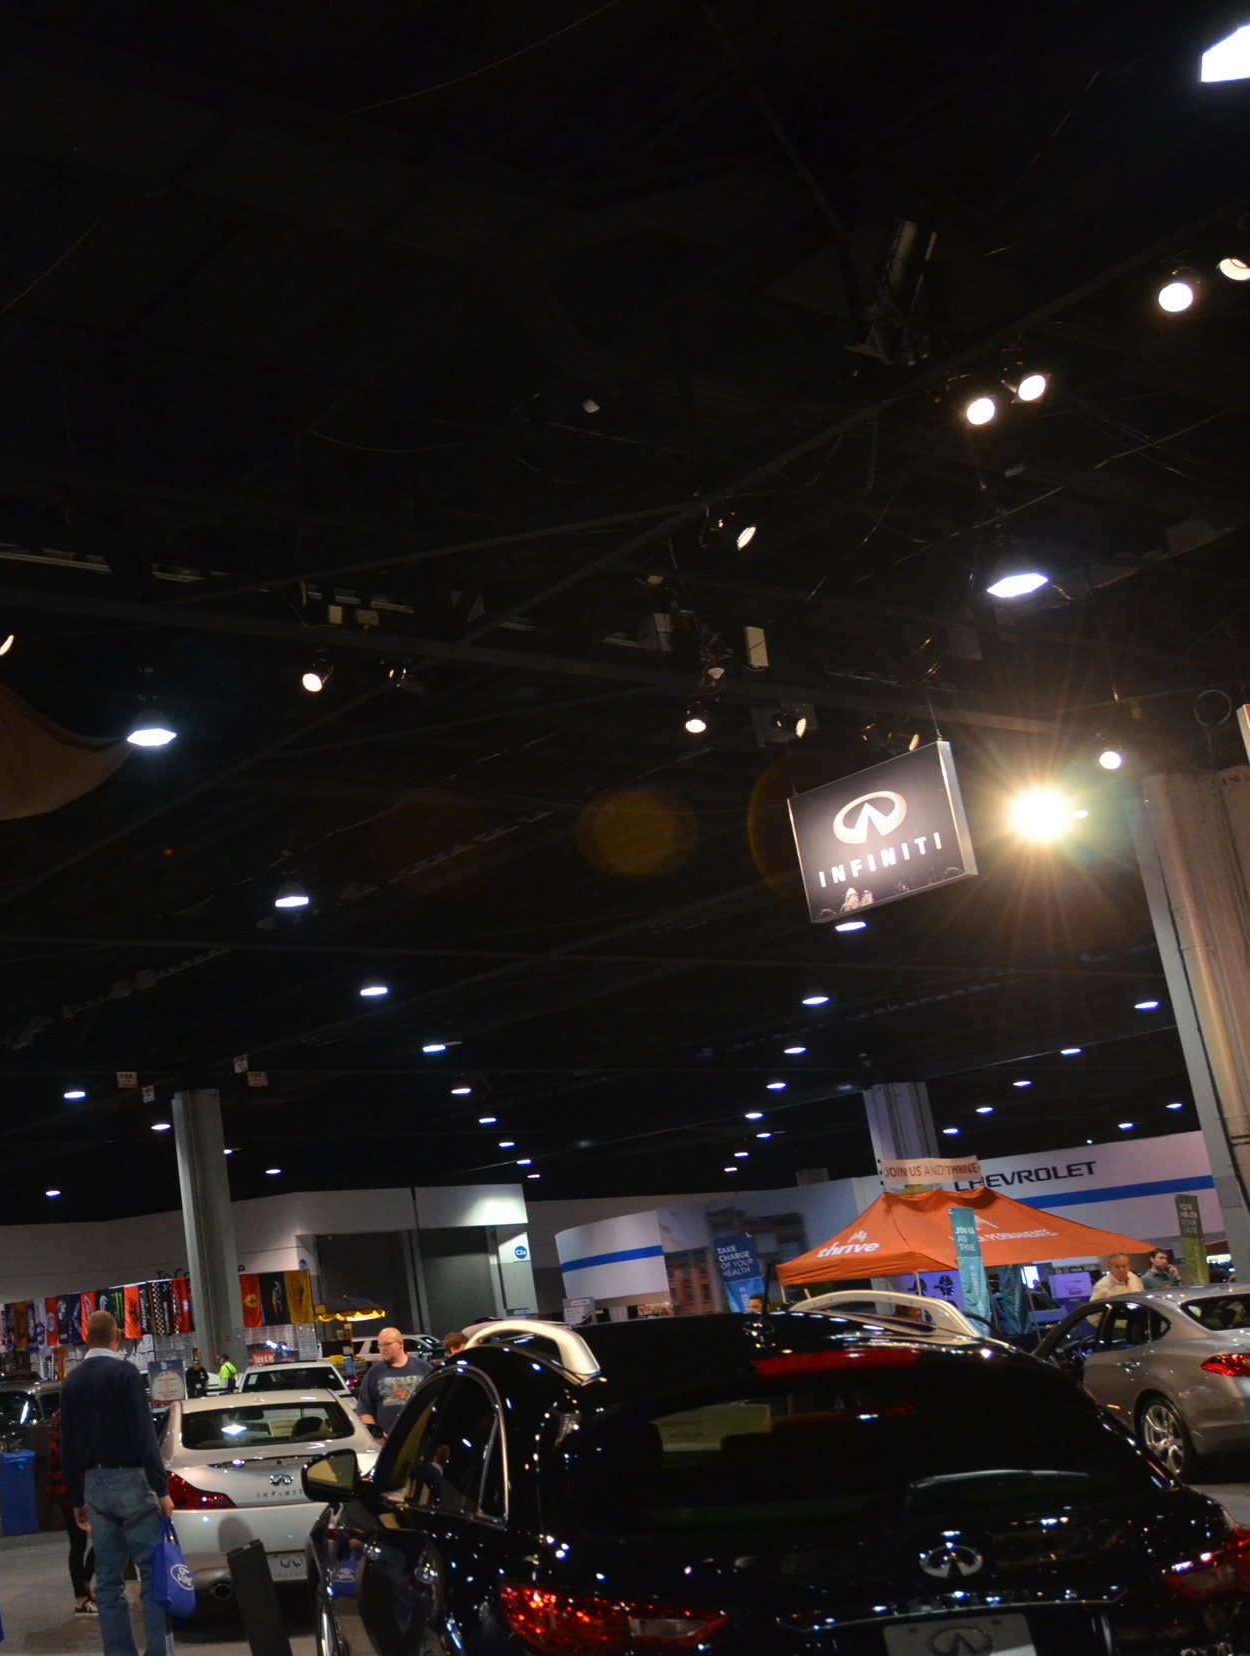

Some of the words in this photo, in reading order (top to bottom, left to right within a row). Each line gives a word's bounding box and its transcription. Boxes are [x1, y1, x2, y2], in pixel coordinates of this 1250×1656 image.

[818, 831, 943, 888] INFINITI
[884, 1166, 908, 1178] JOIN
[910, 1165, 922, 1177] US
[924, 1164, 944, 1176] AND
[945, 1162, 979, 1175] THRIVE
[716, 1245, 737, 1255] TAKE
[718, 1250, 750, 1262] CHARGE
[817, 1241, 880, 1258] thrive
[732, 1257, 754, 1268] YOUR
